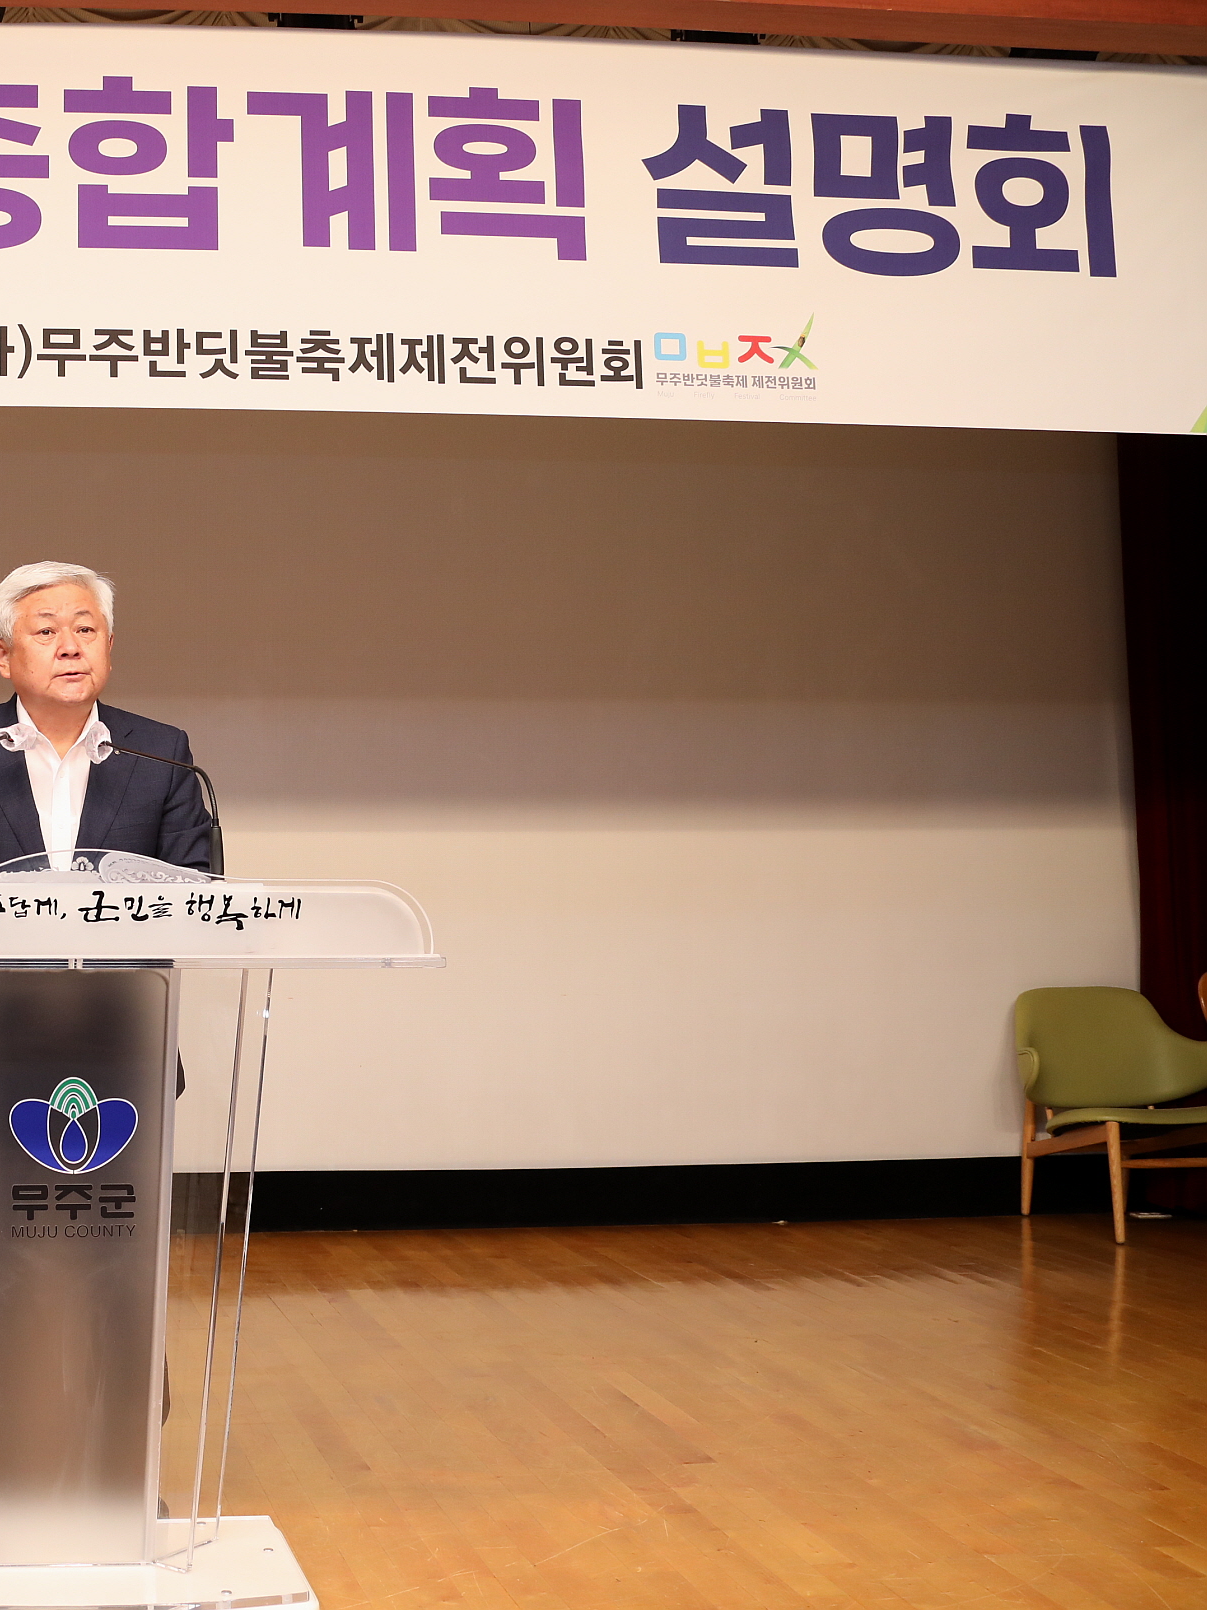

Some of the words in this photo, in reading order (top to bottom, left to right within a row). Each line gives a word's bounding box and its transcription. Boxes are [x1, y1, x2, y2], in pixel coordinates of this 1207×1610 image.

[642, 104, 1117, 277] 설명회
[655, 372, 748, 389] 무주반딧불축제
[751, 375, 816, 391] 제전위원회
[657, 390, 675, 399] Muju
[694, 391, 715, 400] Firefly
[734, 392, 761, 400] Festival
[779, 393, 817, 402] Committee
[78, 891, 173, 922] 군민을
[185, 892, 301, 930] 행복하게
[11, 1183, 136, 1220] 무주군
[11, 1225, 58, 1239] MUJU
[64, 1224, 136, 1238] COUNTY
